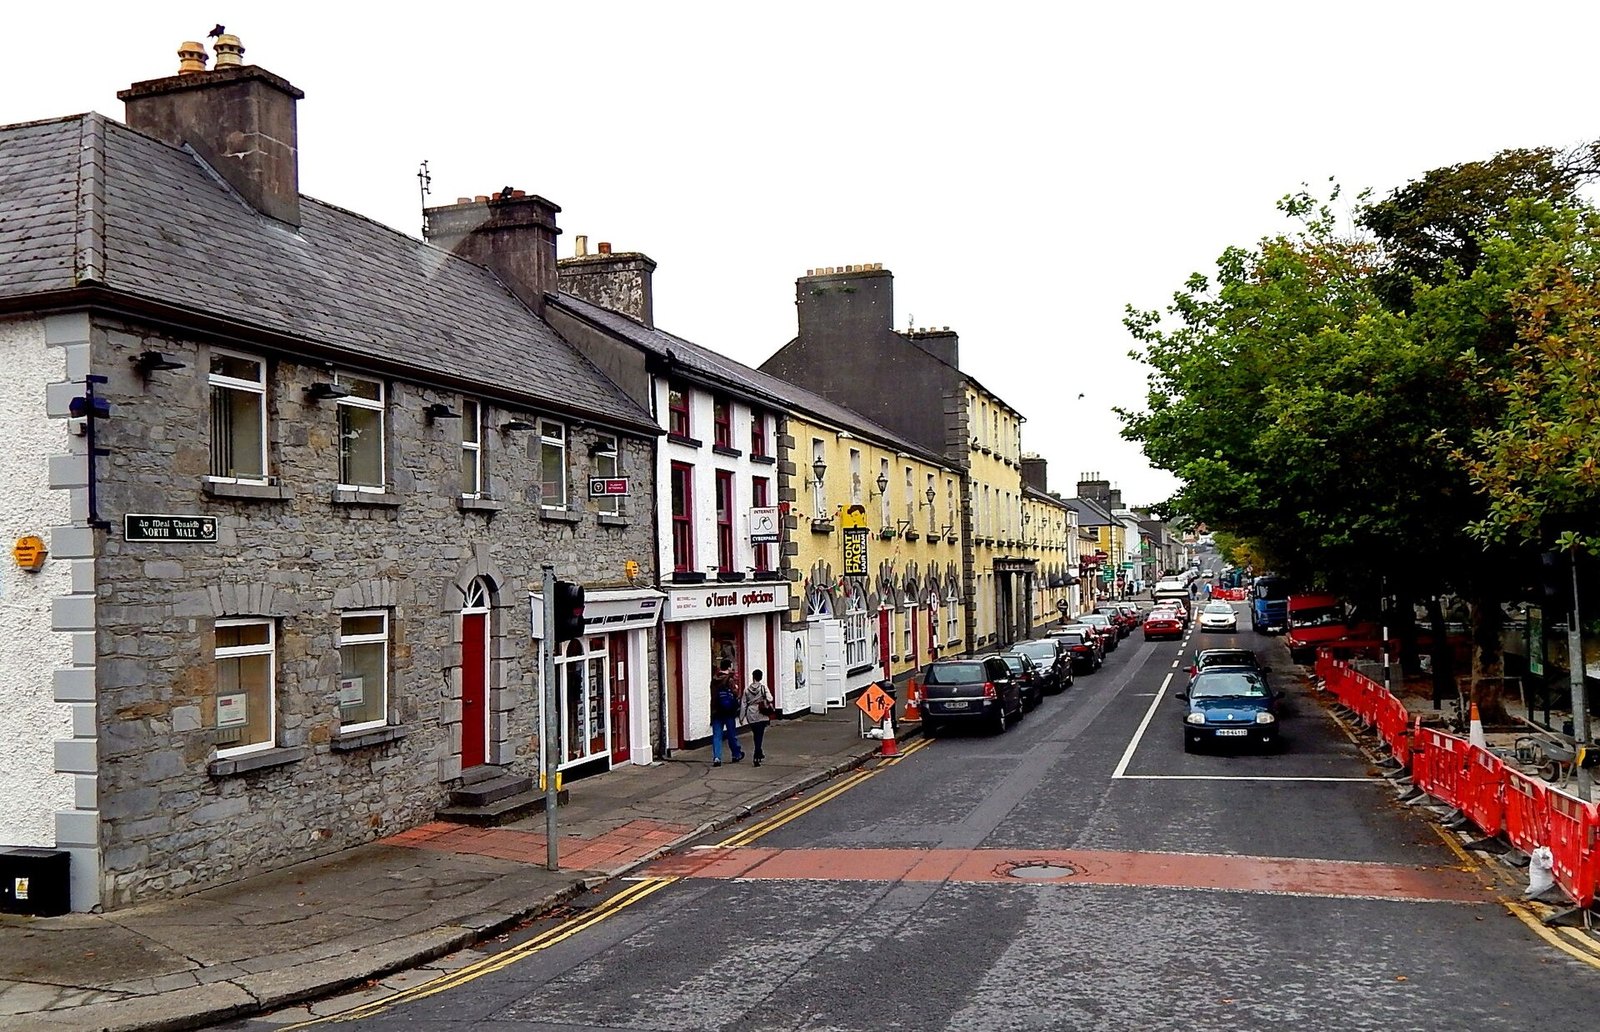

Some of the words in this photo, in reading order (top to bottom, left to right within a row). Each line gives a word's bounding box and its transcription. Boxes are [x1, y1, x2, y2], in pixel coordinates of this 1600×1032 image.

[142, 528, 169, 537] NORTH
[176, 528, 198, 538] MALL
[845, 534, 853, 573] FRONT
[852, 534, 861, 573] PAGE
[742, 590, 774, 608] opticians
